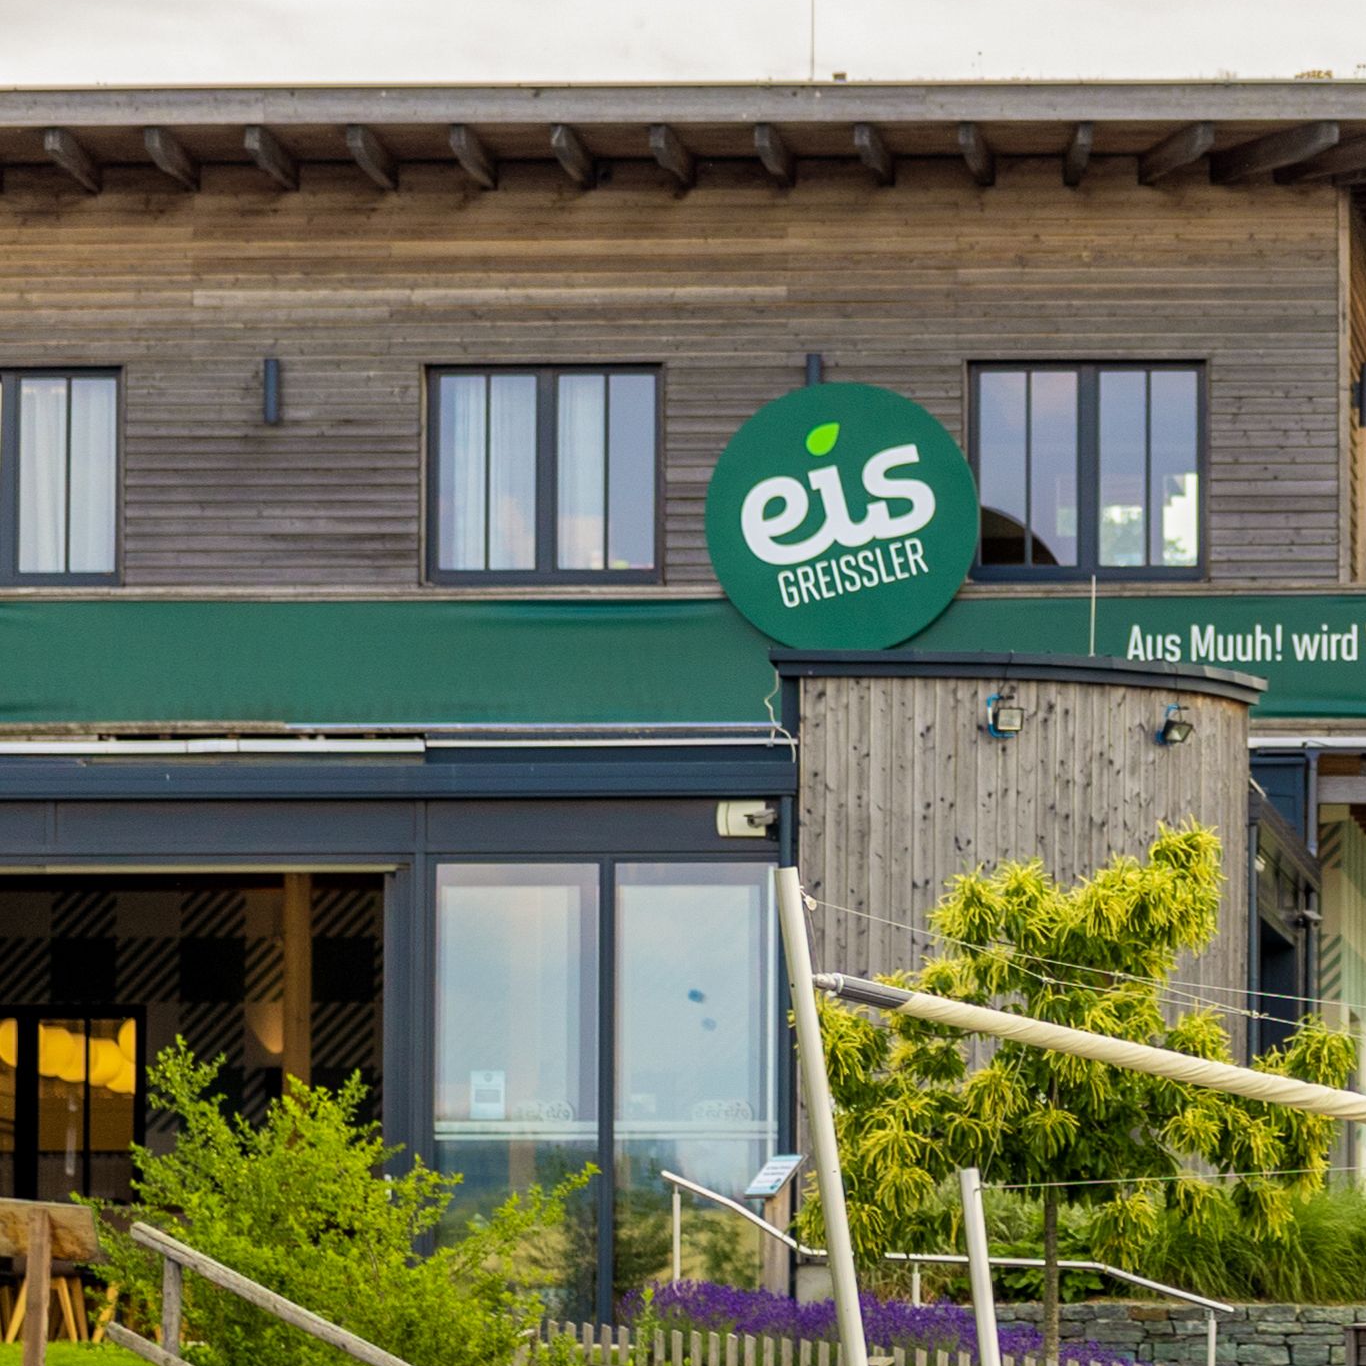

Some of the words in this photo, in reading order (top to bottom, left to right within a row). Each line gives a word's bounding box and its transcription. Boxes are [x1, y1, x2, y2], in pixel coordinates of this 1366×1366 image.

[741, 422, 936, 566] eis
[777, 537, 929, 608] GREISSLER
[1127, 624, 1181, 662] Aus
[1190, 624, 1283, 662] Muuh!
[1292, 623, 1358, 661] wird
